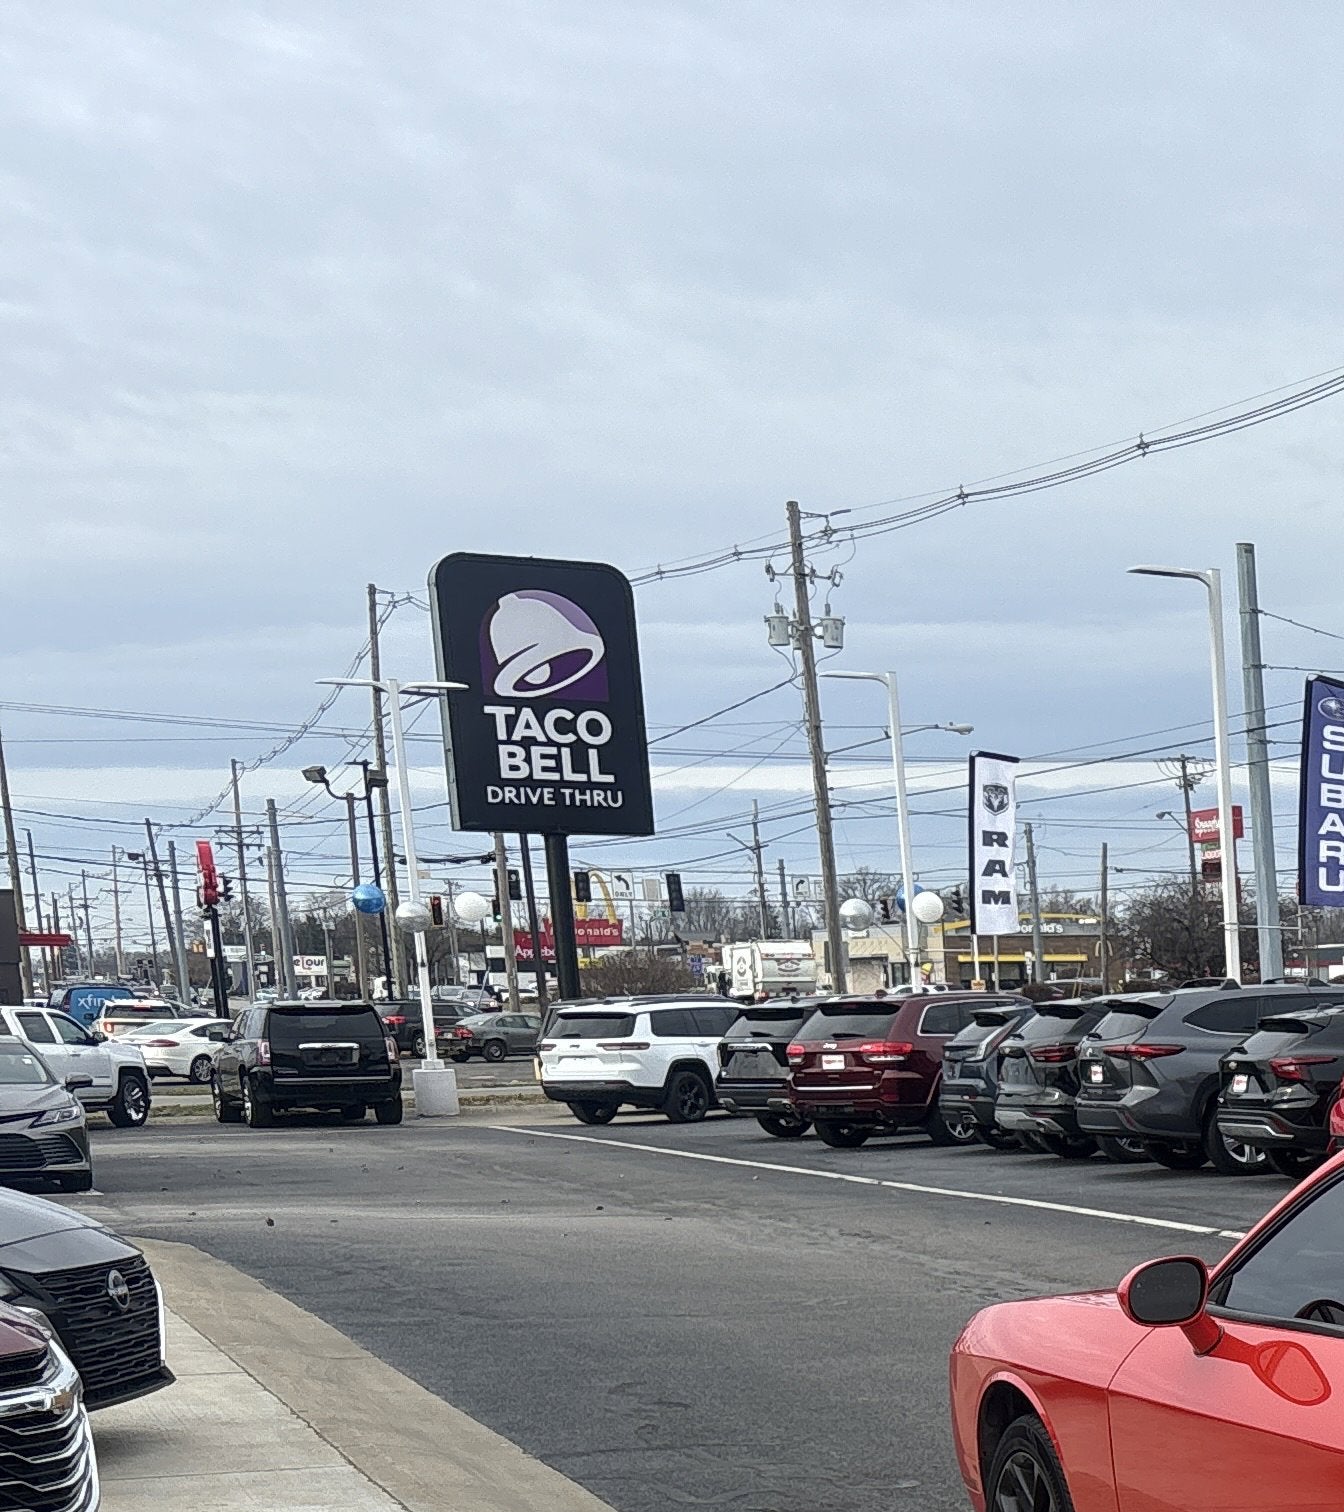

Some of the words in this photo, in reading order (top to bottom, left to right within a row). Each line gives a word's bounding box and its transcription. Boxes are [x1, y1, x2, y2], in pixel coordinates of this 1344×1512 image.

[484, 705, 612, 746] TACO
[498, 744, 616, 783] BELL
[486, 785, 556, 806] DRIVE
[560, 788, 623, 808] THRU
[981, 829, 1011, 905] RAM
